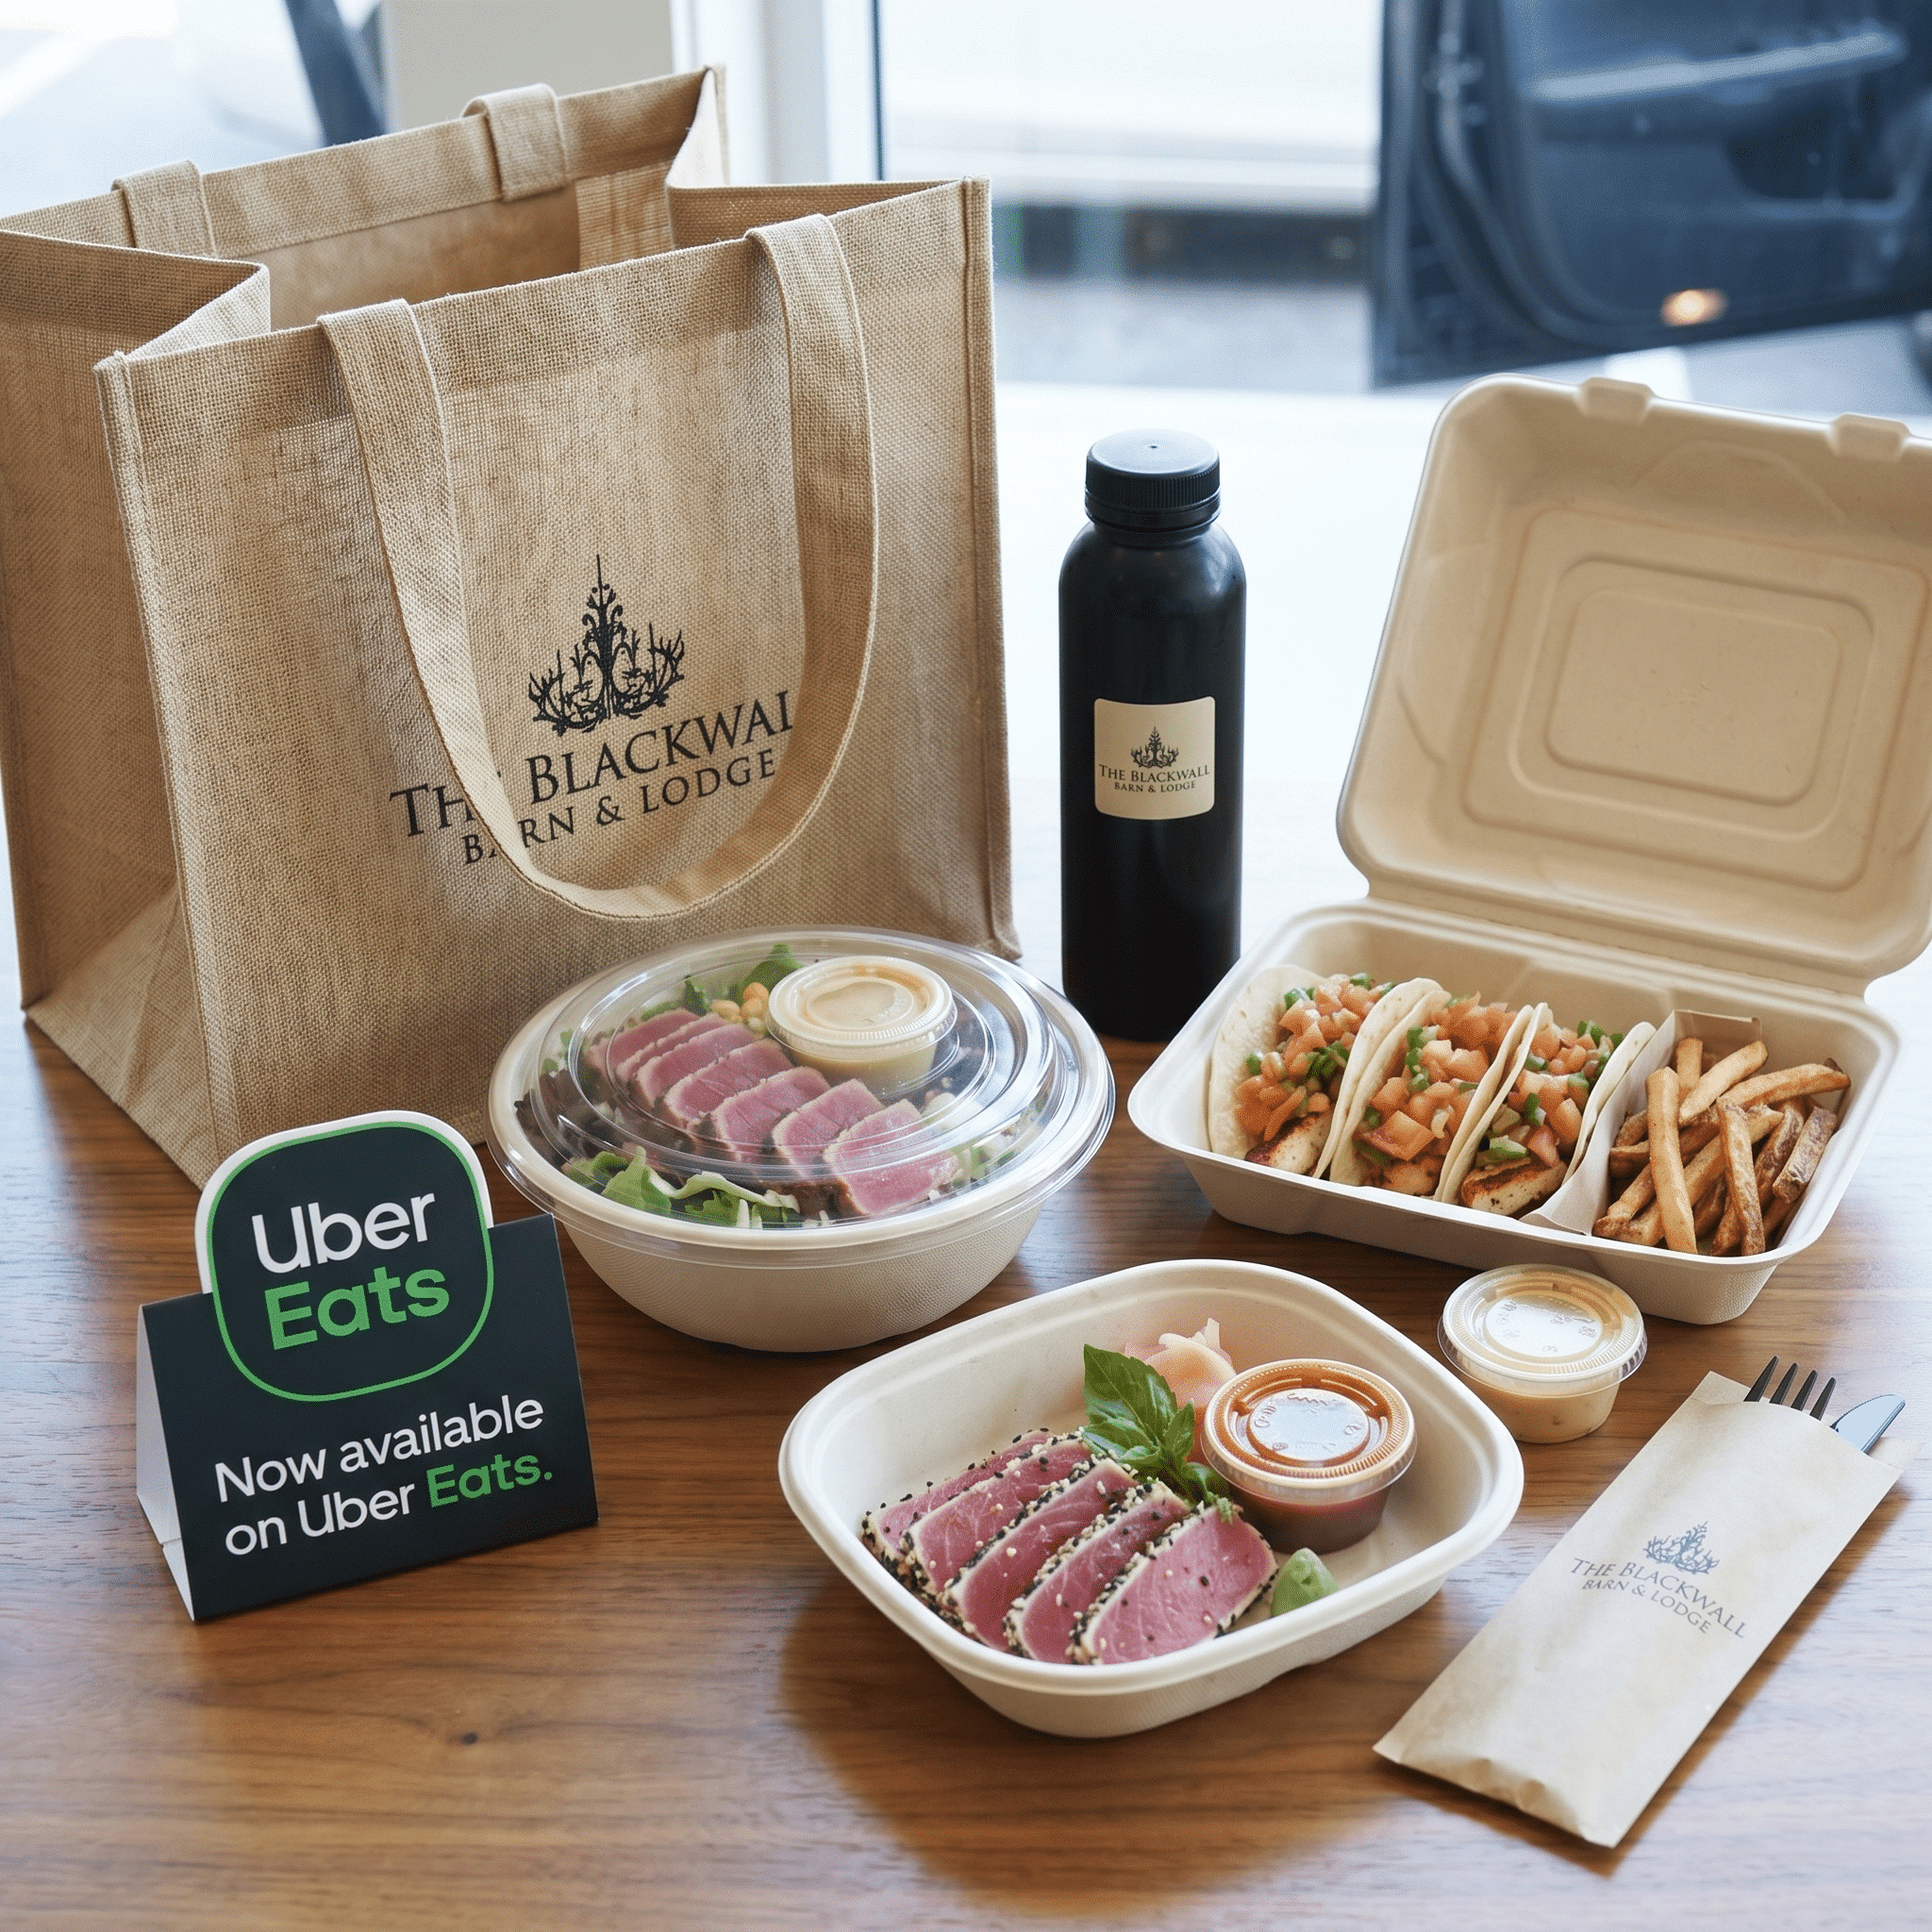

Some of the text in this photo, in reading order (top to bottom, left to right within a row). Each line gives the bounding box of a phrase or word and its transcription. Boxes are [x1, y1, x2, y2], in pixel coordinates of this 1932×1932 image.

[390, 771, 502, 837] TH
[462, 748, 775, 865] BRN & LODGE
[1098, 764, 1210, 783] THE BLACKWALL
[1114, 780, 1197, 793] BARN & LODGE
[252, 1192, 437, 1274] Uber
[264, 1266, 450, 1350] Eats
[215, 1394, 544, 1503] Now available
[225, 1454, 553, 1556] on Uber Eats.
[1571, 1557, 1747, 1638] THE BLACKWALL
[1582, 1579, 1711, 1634] BARN & LODGE
